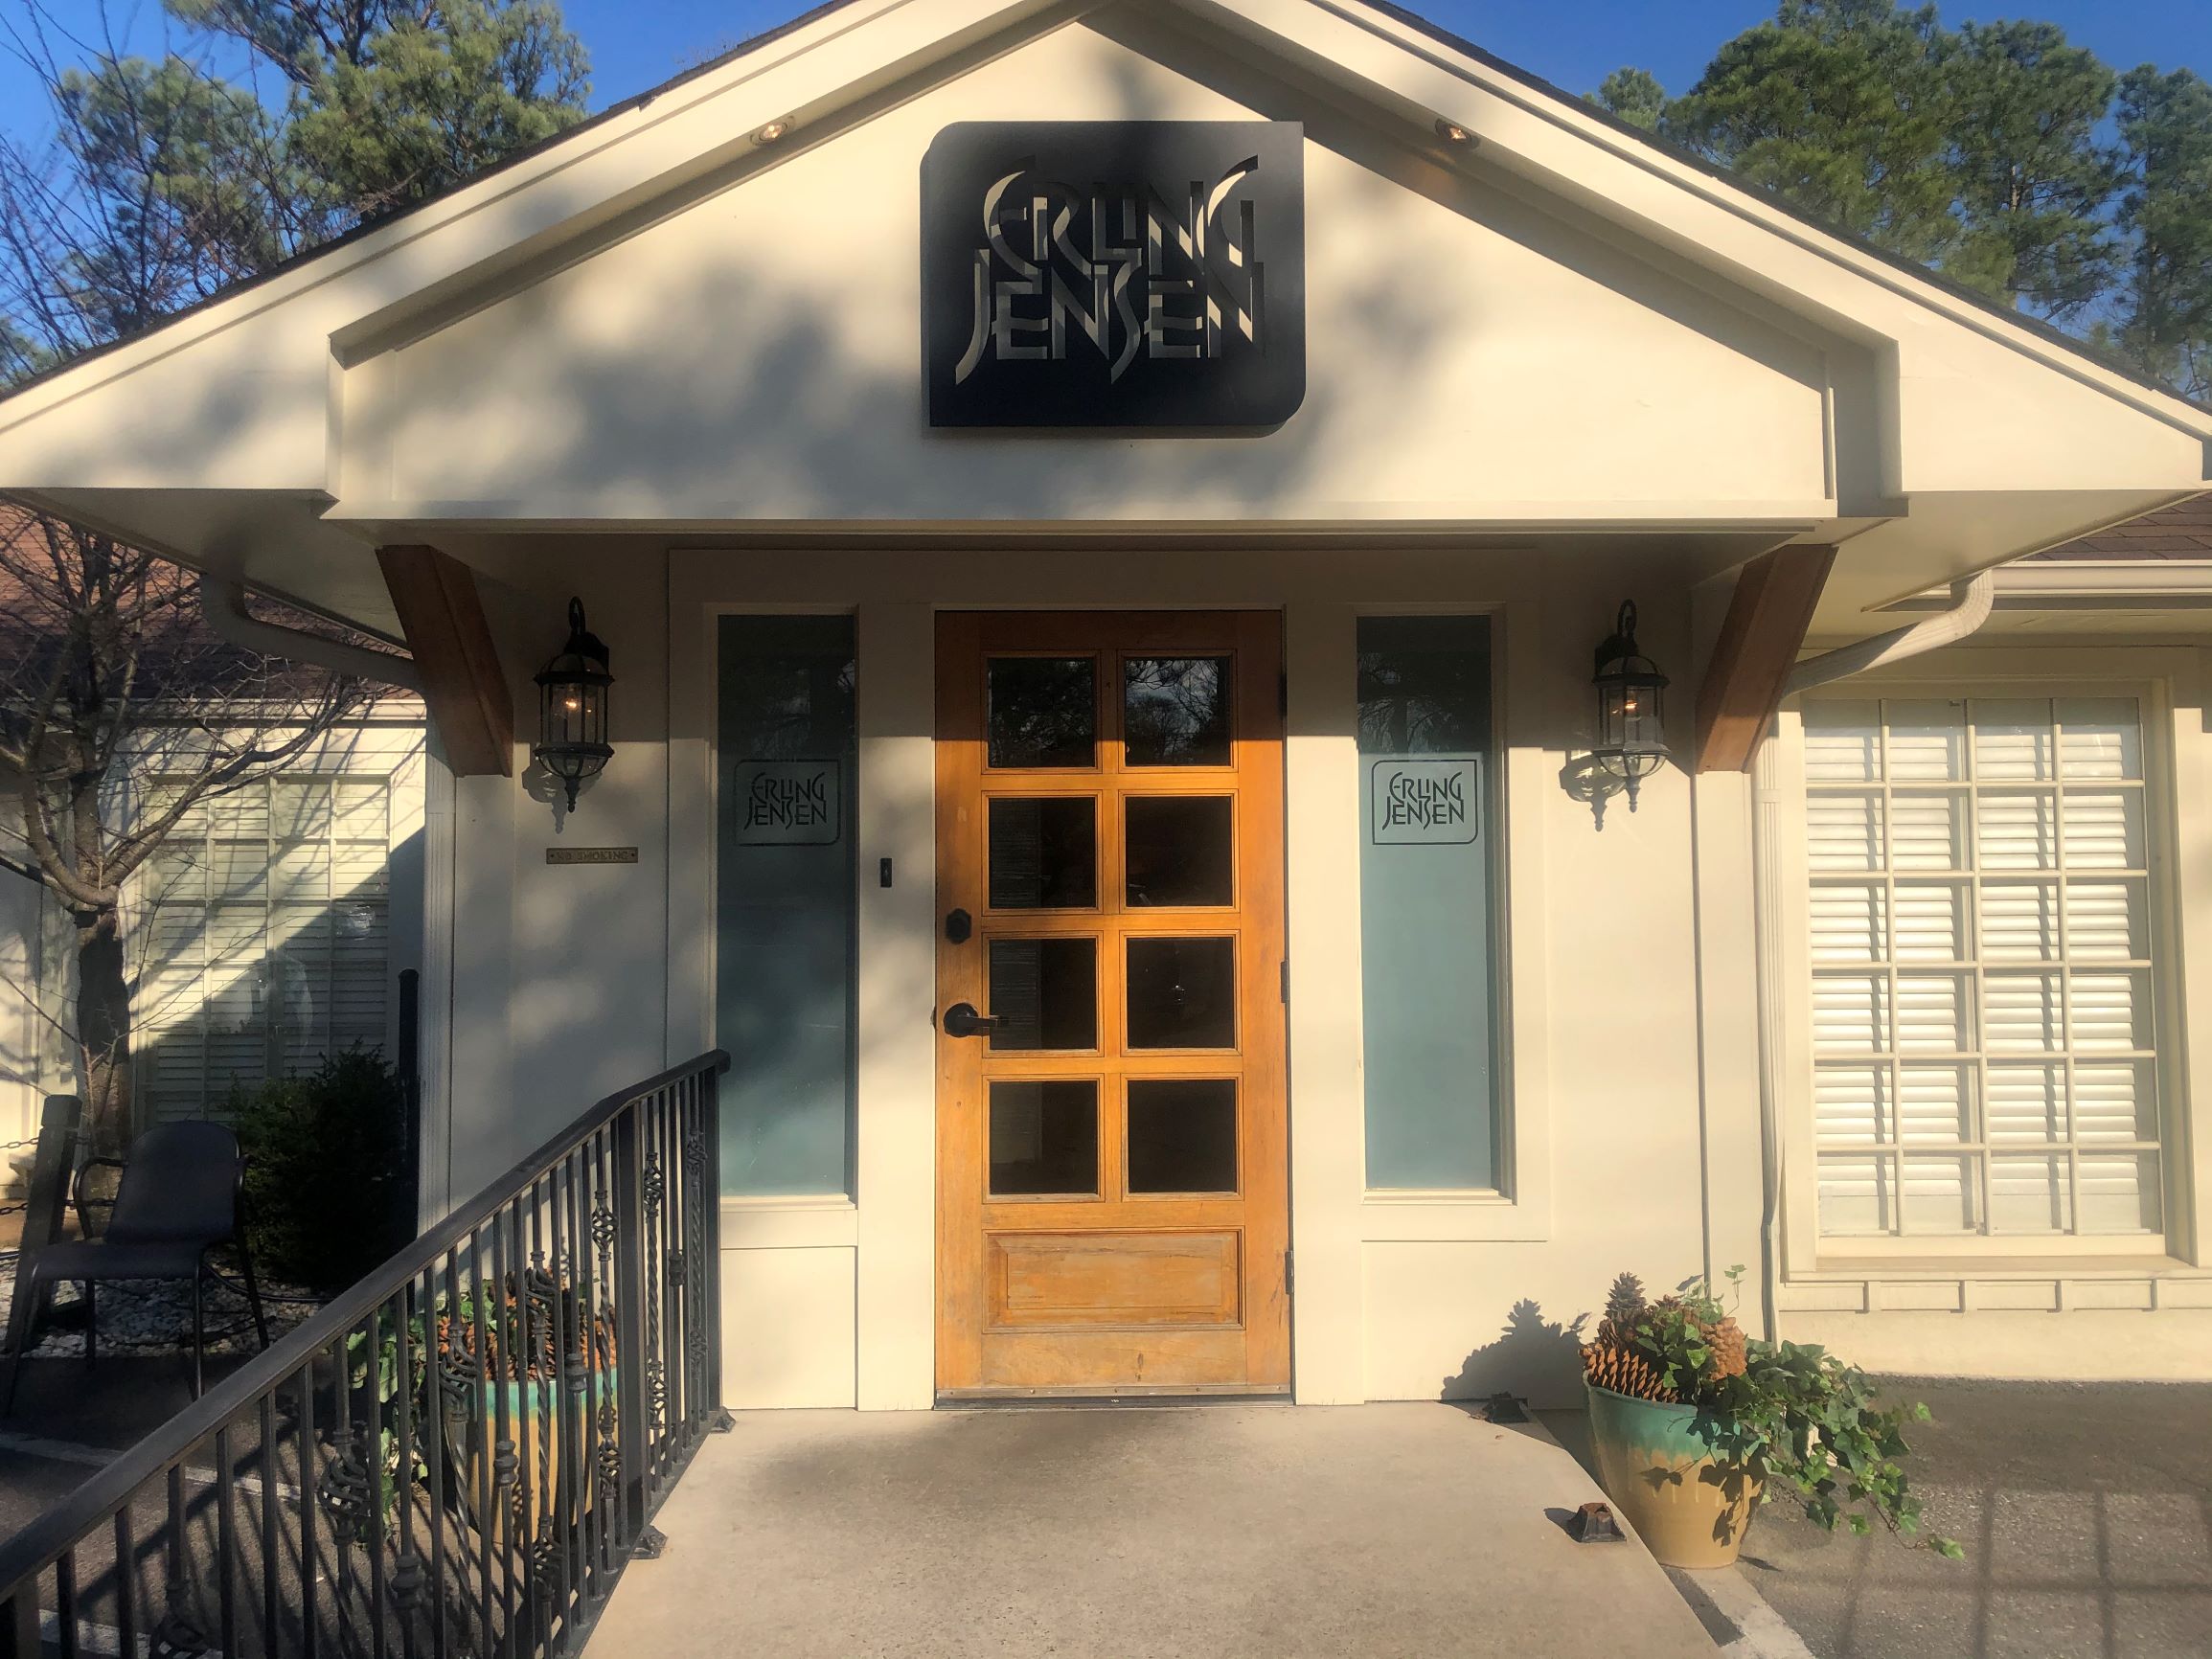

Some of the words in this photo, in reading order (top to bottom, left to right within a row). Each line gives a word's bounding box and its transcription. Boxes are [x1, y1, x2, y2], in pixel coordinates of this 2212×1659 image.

[983, 154, 1259, 280] ERLING
[955, 248, 1266, 385] JENSEN
[751, 771, 826, 805] ERLING
[1389, 771, 1462, 805] ERLING
[743, 796, 827, 831] JENSEN
[1381, 796, 1464, 830] JENSEN
[556, 851, 572, 860] NO
[577, 850, 628, 861] SMOKING
